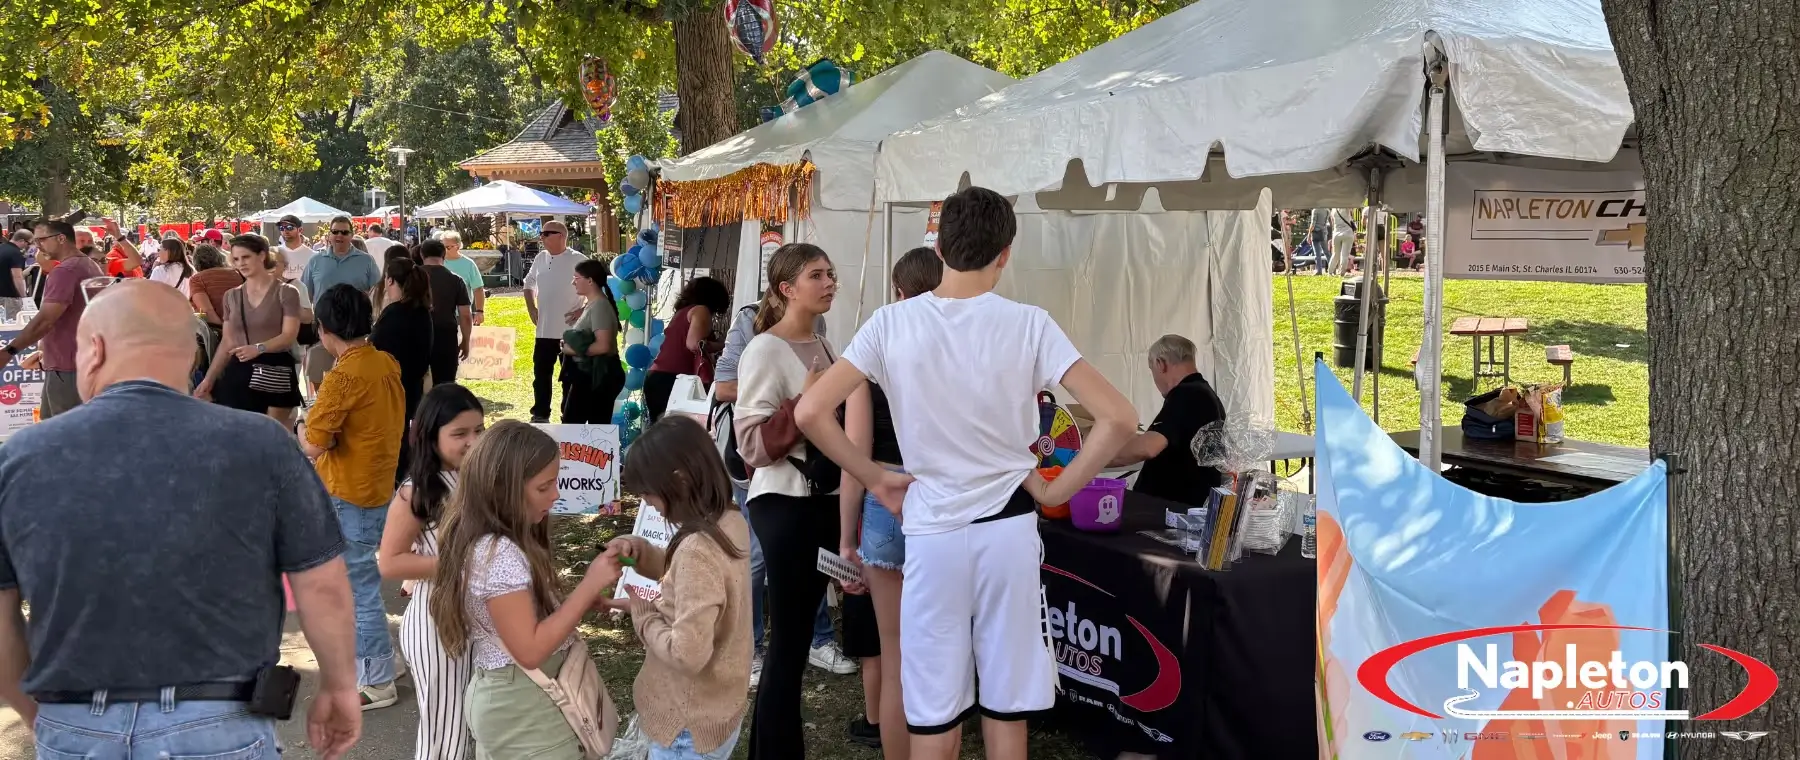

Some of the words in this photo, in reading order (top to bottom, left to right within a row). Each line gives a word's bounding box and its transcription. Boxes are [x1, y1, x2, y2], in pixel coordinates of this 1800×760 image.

[1478, 197, 1595, 219] NAPLETON
[1468, 264, 1484, 272] 2015
[1485, 264, 1490, 272] E
[1492, 264, 1510, 273] Main
[1523, 264, 1533, 273] St.
[1535, 264, 1564, 274] Charles
[1565, 265, 1572, 274] IL
[1574, 265, 1598, 274] 60174
[558, 477, 603, 491] WORKS
[641, 528, 664, 541] MAGIC
